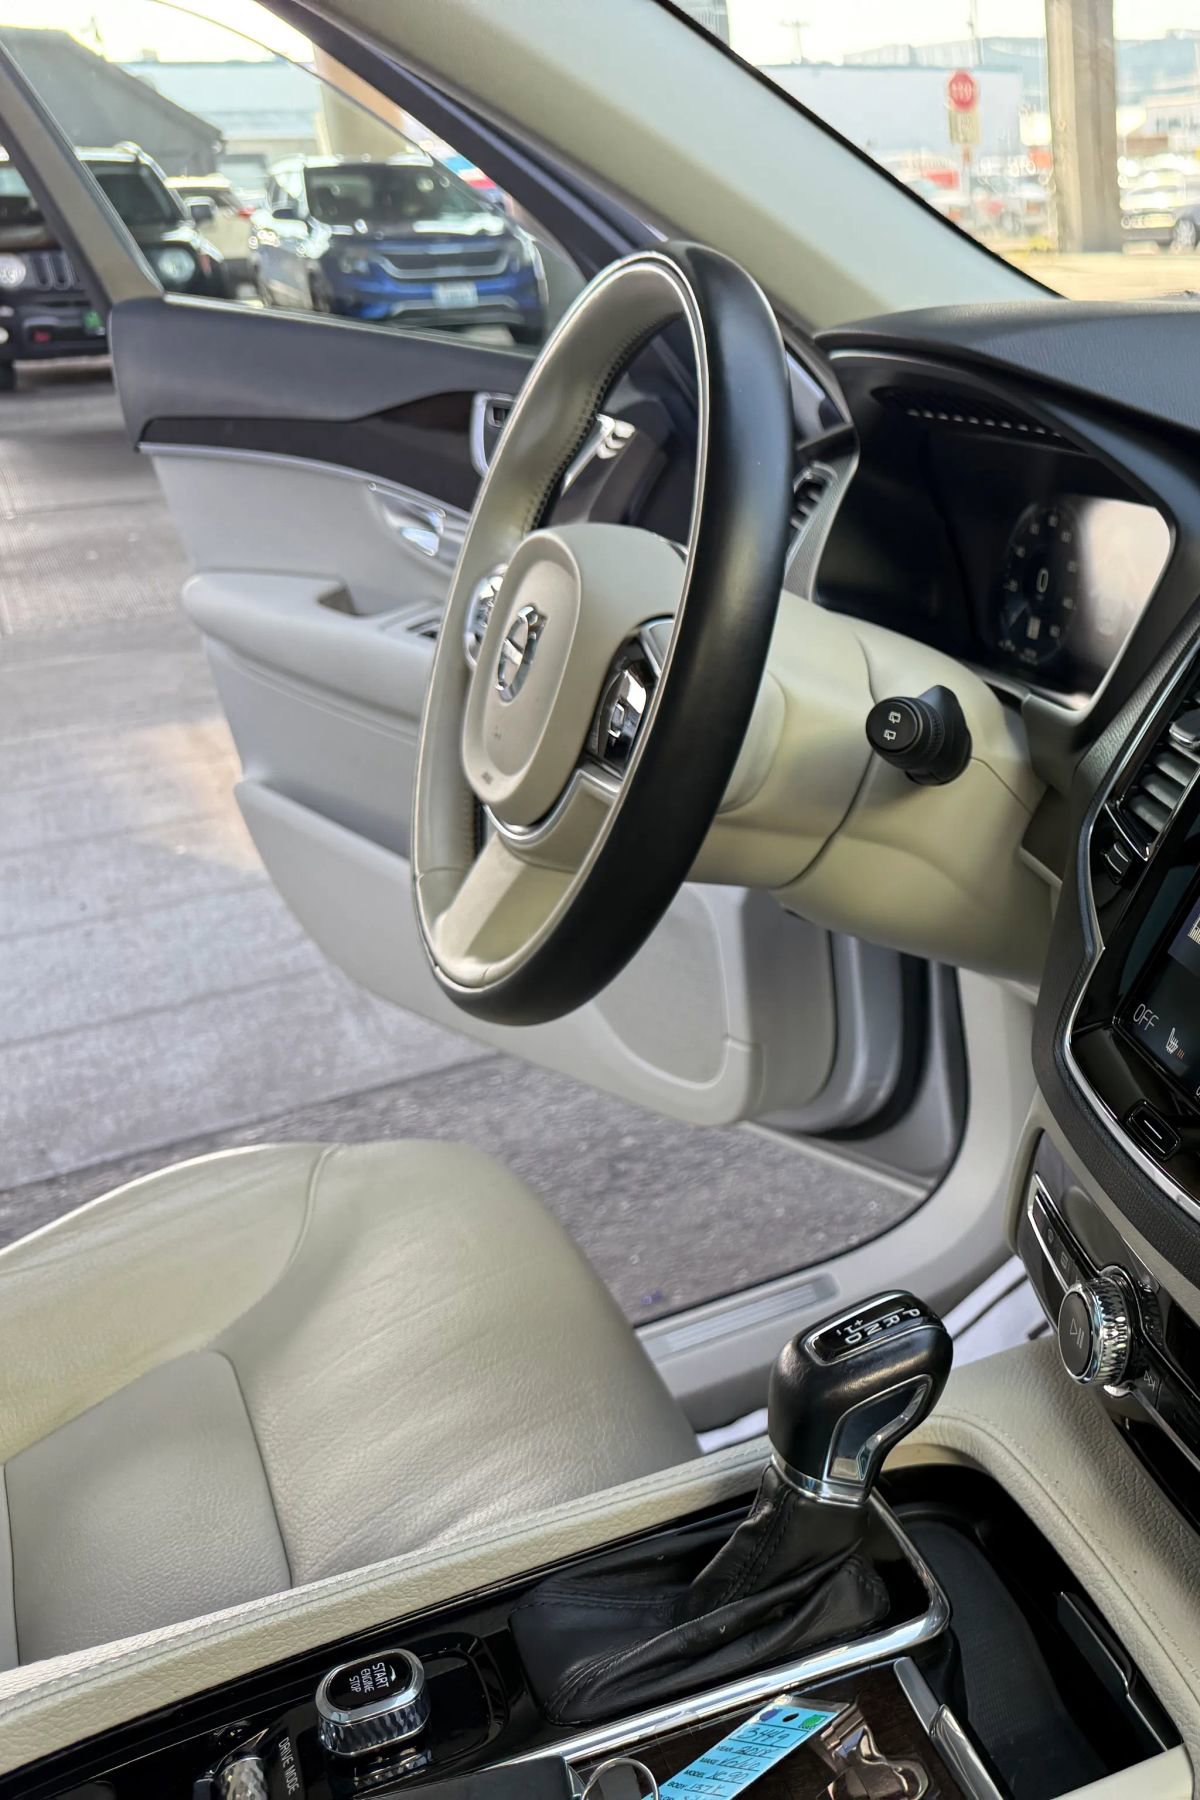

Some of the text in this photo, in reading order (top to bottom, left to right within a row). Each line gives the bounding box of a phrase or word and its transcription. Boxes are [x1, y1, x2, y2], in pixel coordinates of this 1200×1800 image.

[1133, 1003, 1160, 1031] OFF
[844, 1308, 921, 1345] P R N D
[348, 1675, 362, 1693] STOP
[360, 1668, 375, 1694] ENGINE
[372, 1662, 390, 1689] START
[278, 1736, 300, 1796] DRIVE MODE
[683, 1769, 706, 1779] MODEL
[667, 1781, 688, 1790] BODY
